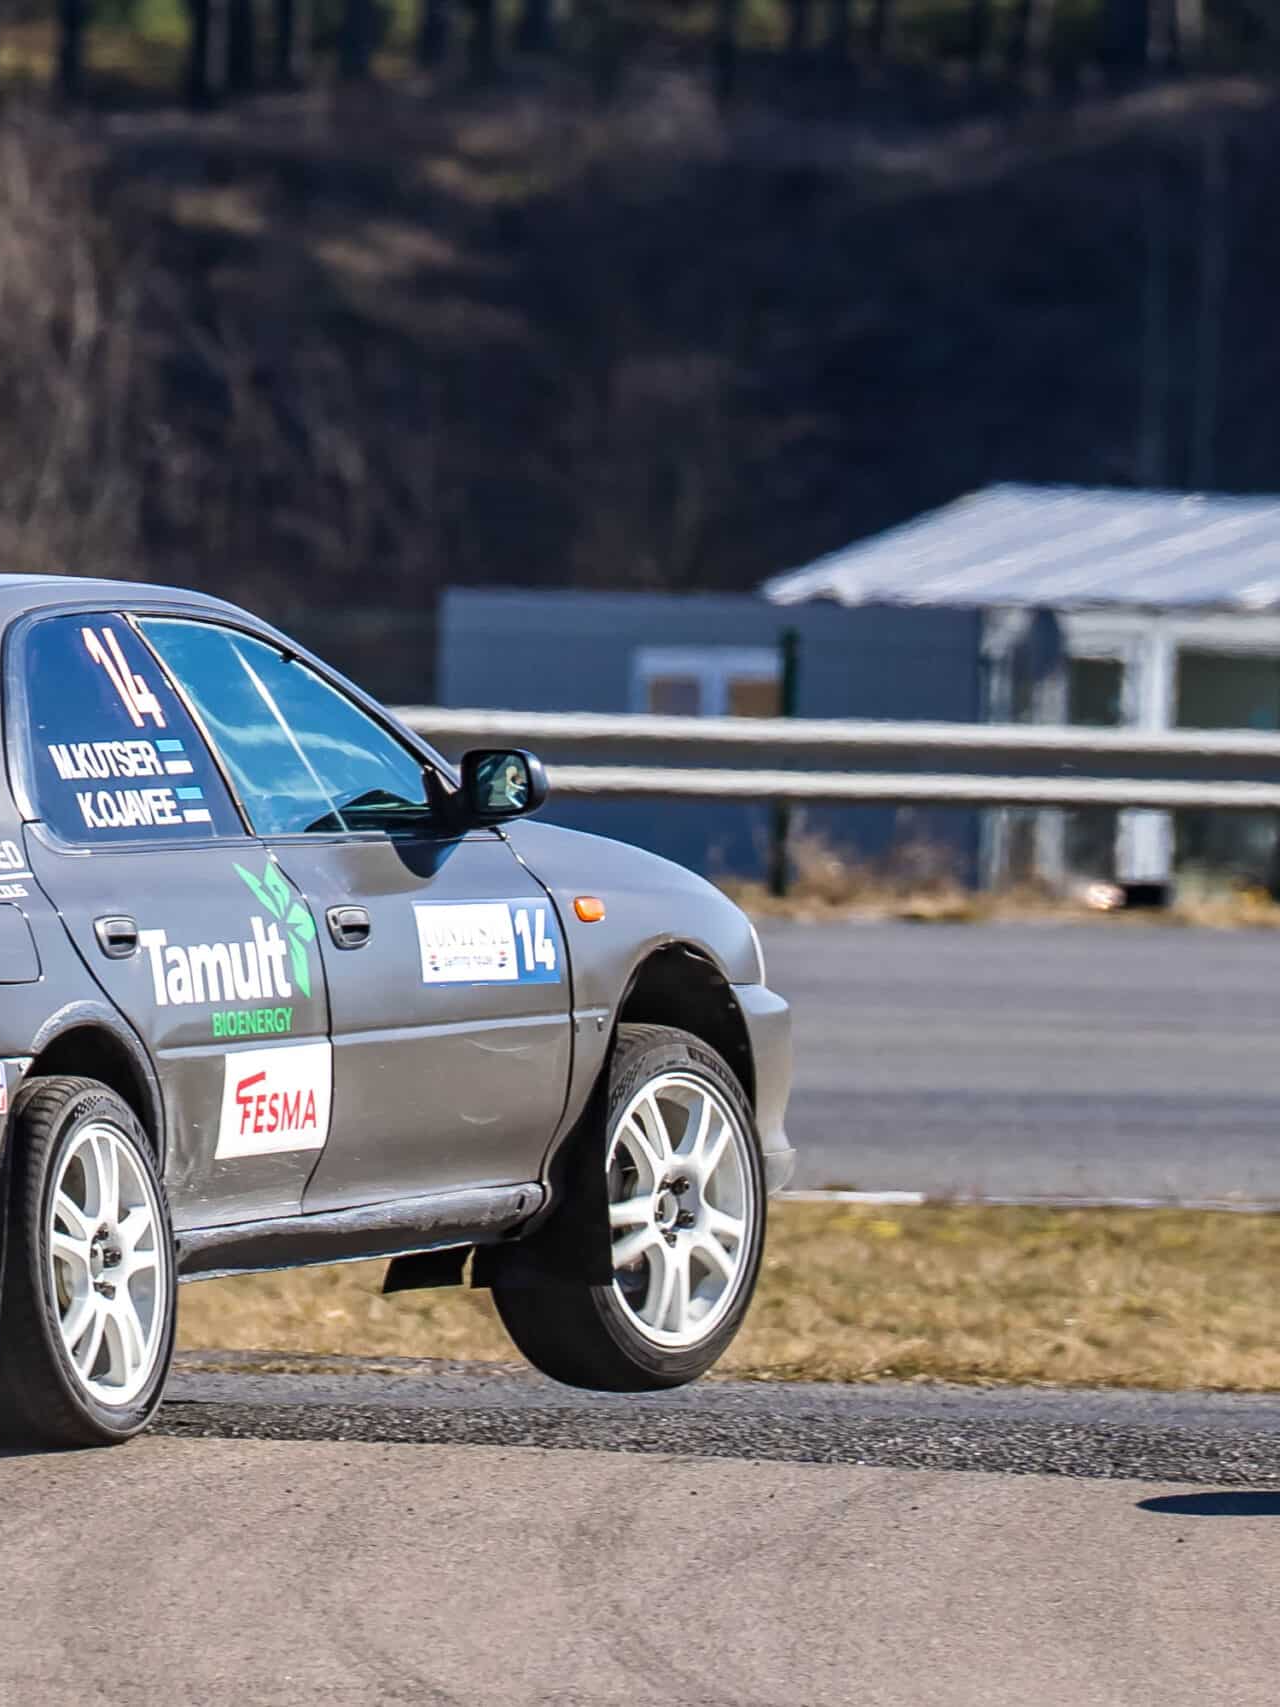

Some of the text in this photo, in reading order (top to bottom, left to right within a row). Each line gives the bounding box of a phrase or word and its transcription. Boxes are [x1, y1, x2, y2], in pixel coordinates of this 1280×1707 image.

[81, 628, 166, 728] 14
[138, 916, 292, 1006] Tamult
[514, 909, 556, 971] 14
[212, 1007, 293, 1037] BIOENERGY
[236, 1071, 318, 1136] FESMA
